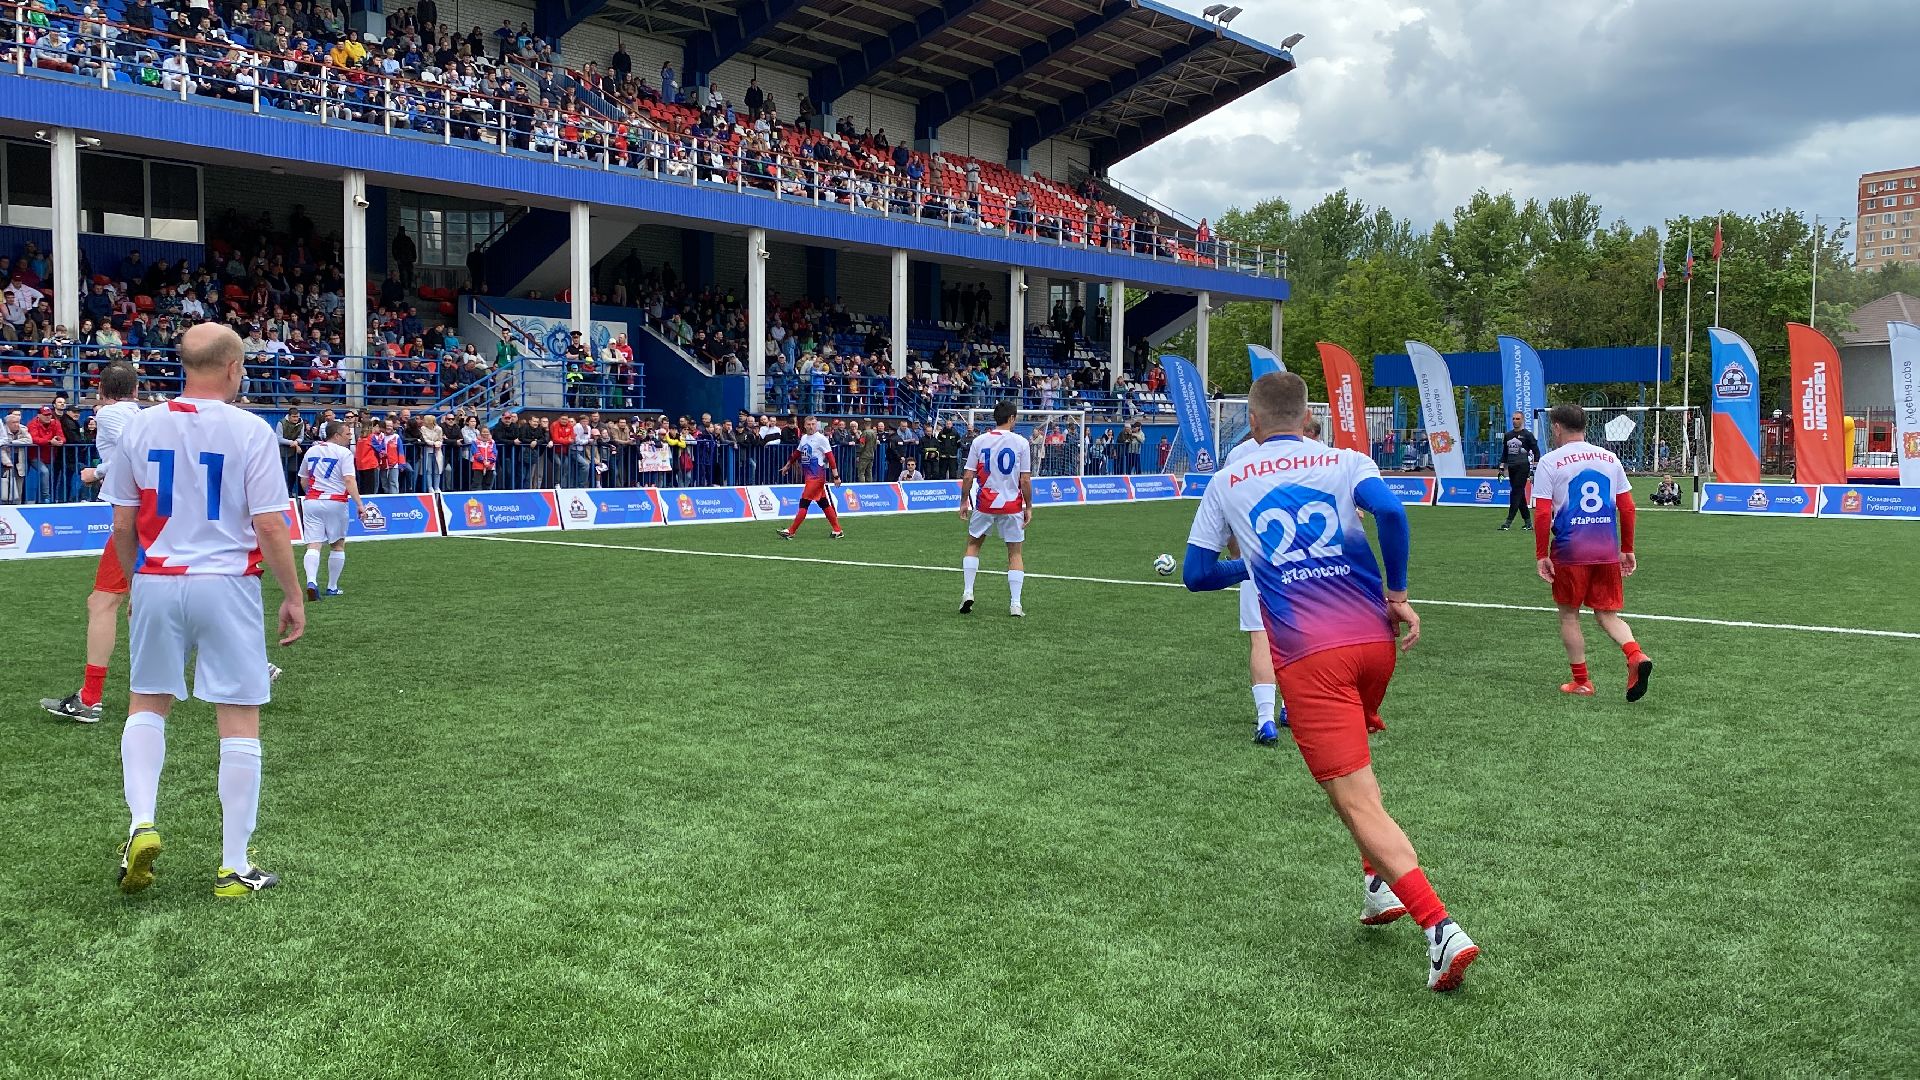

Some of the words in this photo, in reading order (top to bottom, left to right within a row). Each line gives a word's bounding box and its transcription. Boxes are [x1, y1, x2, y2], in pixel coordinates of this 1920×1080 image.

[307, 456, 339, 479] 77
[980, 447, 1016, 475] 10
[1229, 454, 1339, 488] АЛДОНИН
[1556, 452, 1615, 470] АЛЕНИЧЕВ
[147, 449, 225, 521] 11
[487, 504, 521, 512] Команда
[1579, 481, 1604, 513] 8
[1866, 495, 1902, 503] Команда
[1866, 503, 1917, 513] Губернатора
[489, 513, 536, 524] Губернатора
[1255, 500, 1343, 567] 22
